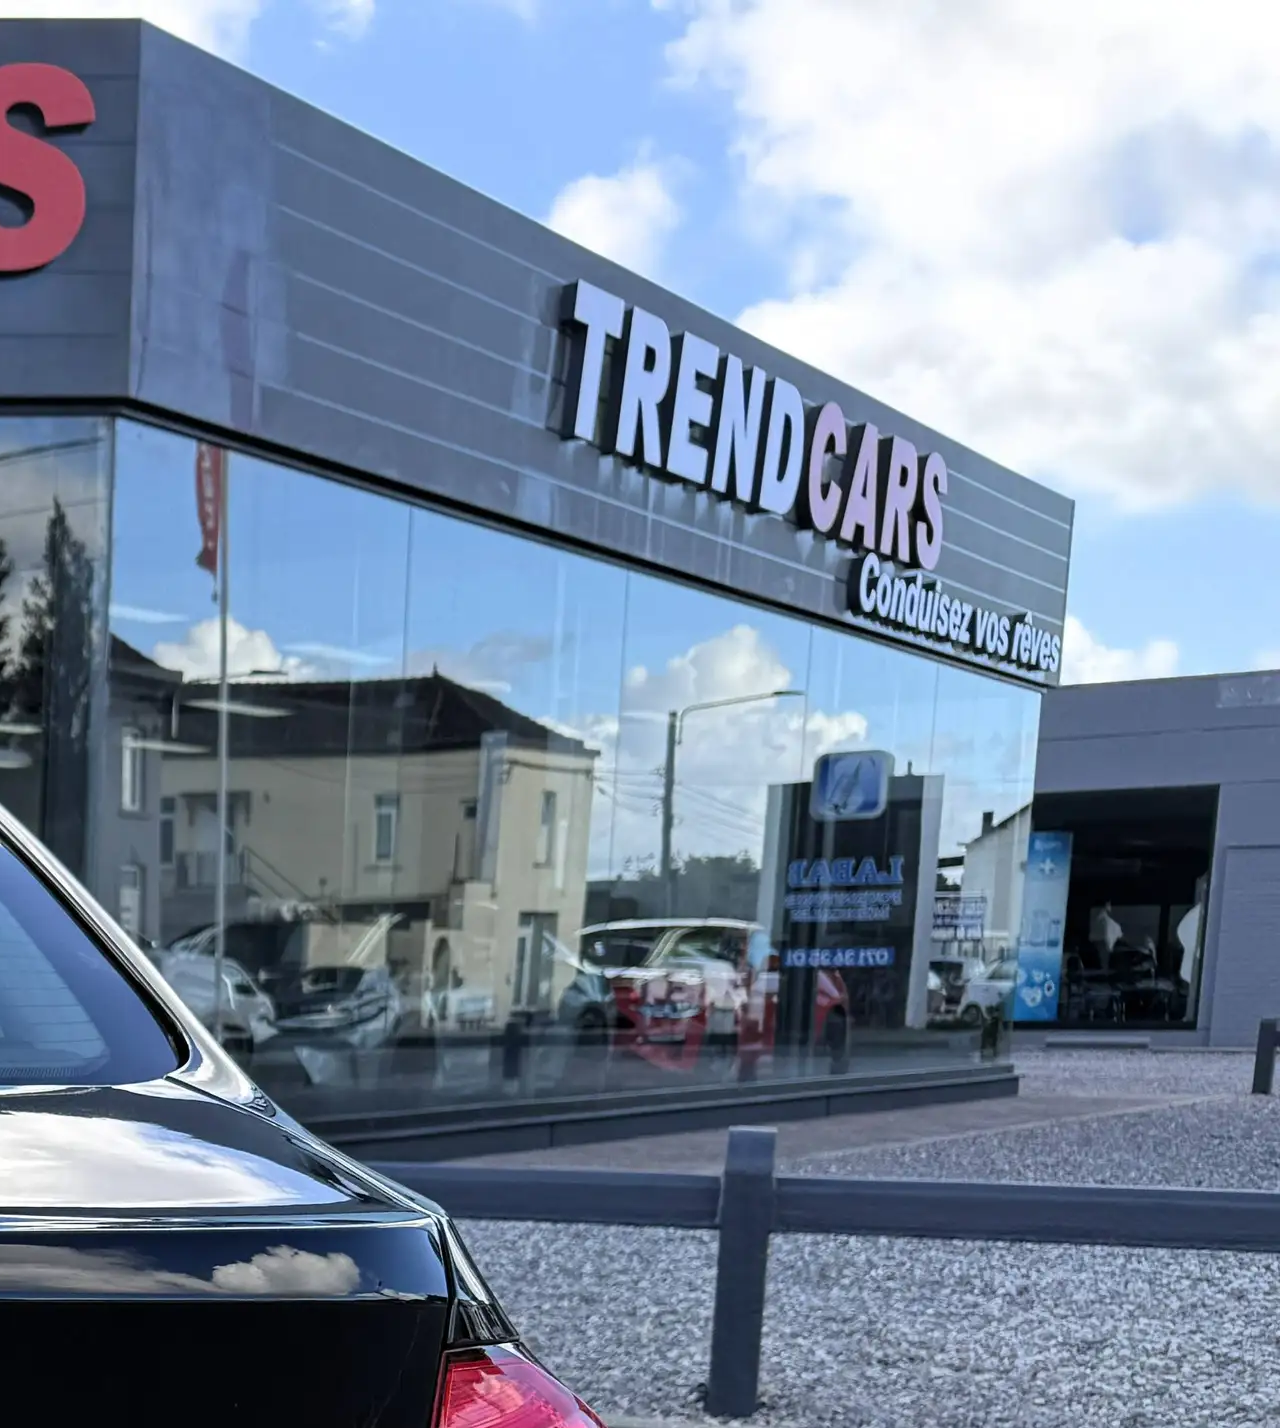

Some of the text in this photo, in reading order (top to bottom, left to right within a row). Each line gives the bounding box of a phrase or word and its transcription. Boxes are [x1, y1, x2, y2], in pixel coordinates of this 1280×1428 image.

[859, 552, 1061, 673] Conduisez vos rêves
